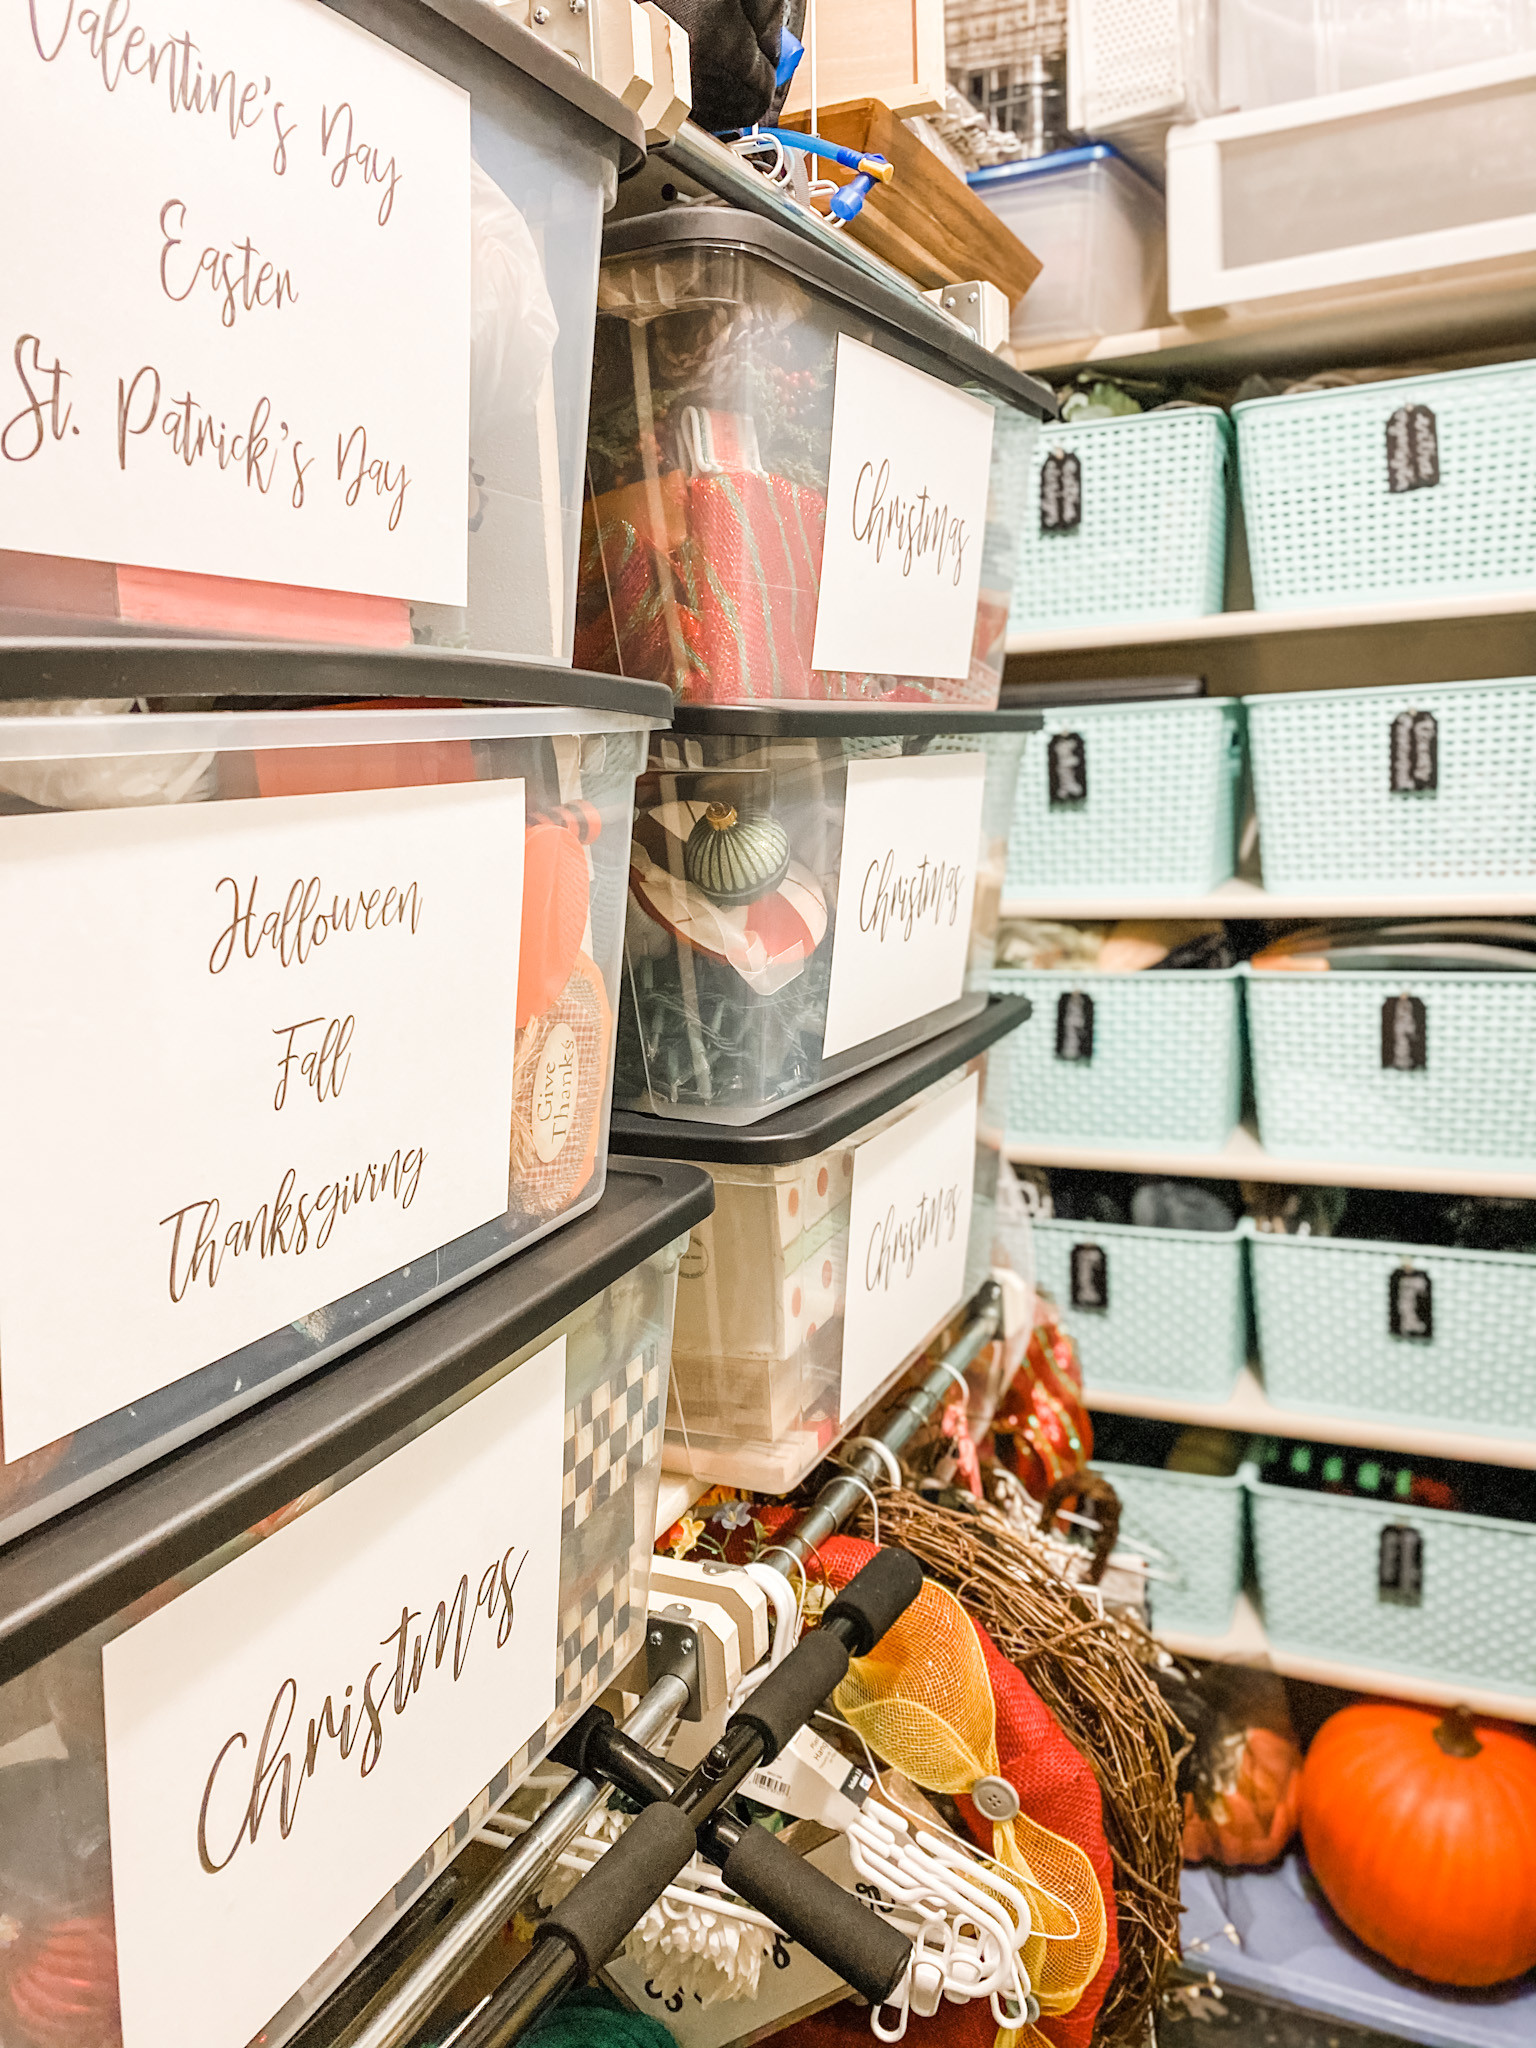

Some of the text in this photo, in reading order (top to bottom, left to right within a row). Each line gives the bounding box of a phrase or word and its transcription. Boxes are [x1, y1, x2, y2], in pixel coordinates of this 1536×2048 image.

[320, 102, 403, 226] Day
[159, 199, 299, 328] Easter
[1, 333, 412, 532] St. Patrick's Day
[852, 458, 970, 586] Christmas
[208, 874, 423, 975] Halloween
[859, 848, 965, 943] Christmas
[271, 1014, 356, 1112] Fall
[536, 1060, 557, 1122] Give
[551, 1039, 576, 1144] Thanks
[159, 1146, 430, 1303] Thanksgiving
[865, 1183, 963, 1293] Christmas
[197, 1545, 530, 1875] Christmas
